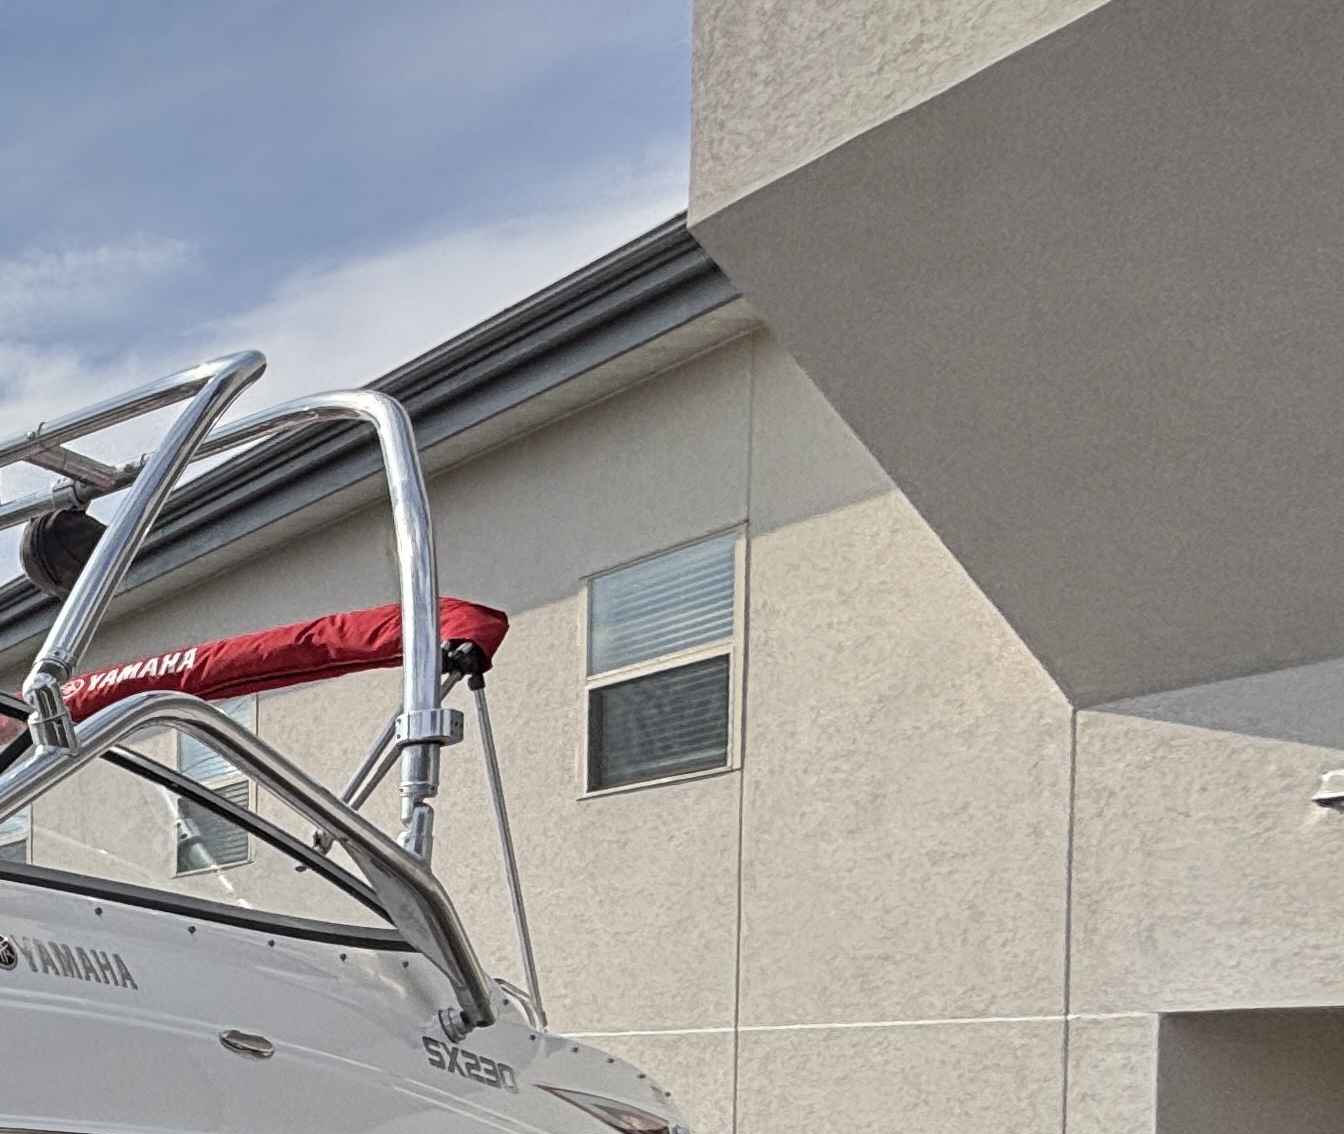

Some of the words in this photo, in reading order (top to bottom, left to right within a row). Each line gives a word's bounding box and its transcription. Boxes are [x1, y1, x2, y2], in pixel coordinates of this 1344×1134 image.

[88, 649, 197, 691] YAMAHA
[10, 935, 139, 990] YAMAHA
[422, 1036, 519, 1094] SX230
